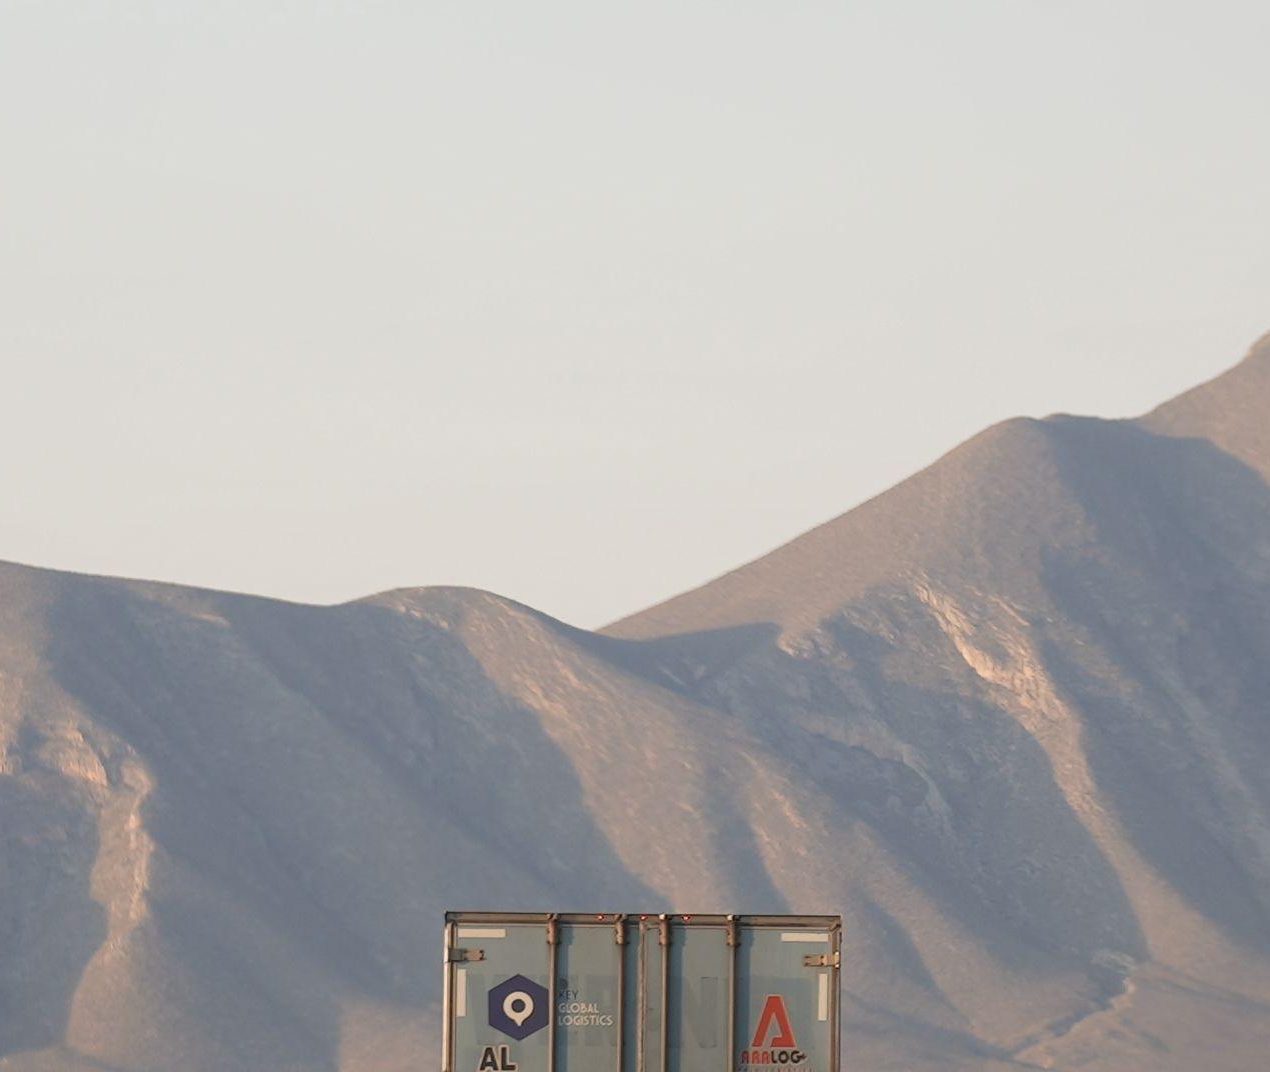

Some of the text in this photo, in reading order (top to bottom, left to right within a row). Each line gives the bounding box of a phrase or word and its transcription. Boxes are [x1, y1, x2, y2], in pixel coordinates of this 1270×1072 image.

[559, 1002, 599, 1014] GLOBAL
[558, 1015, 613, 1026] LOGISTICS
[479, 1046, 517, 1071] AL
